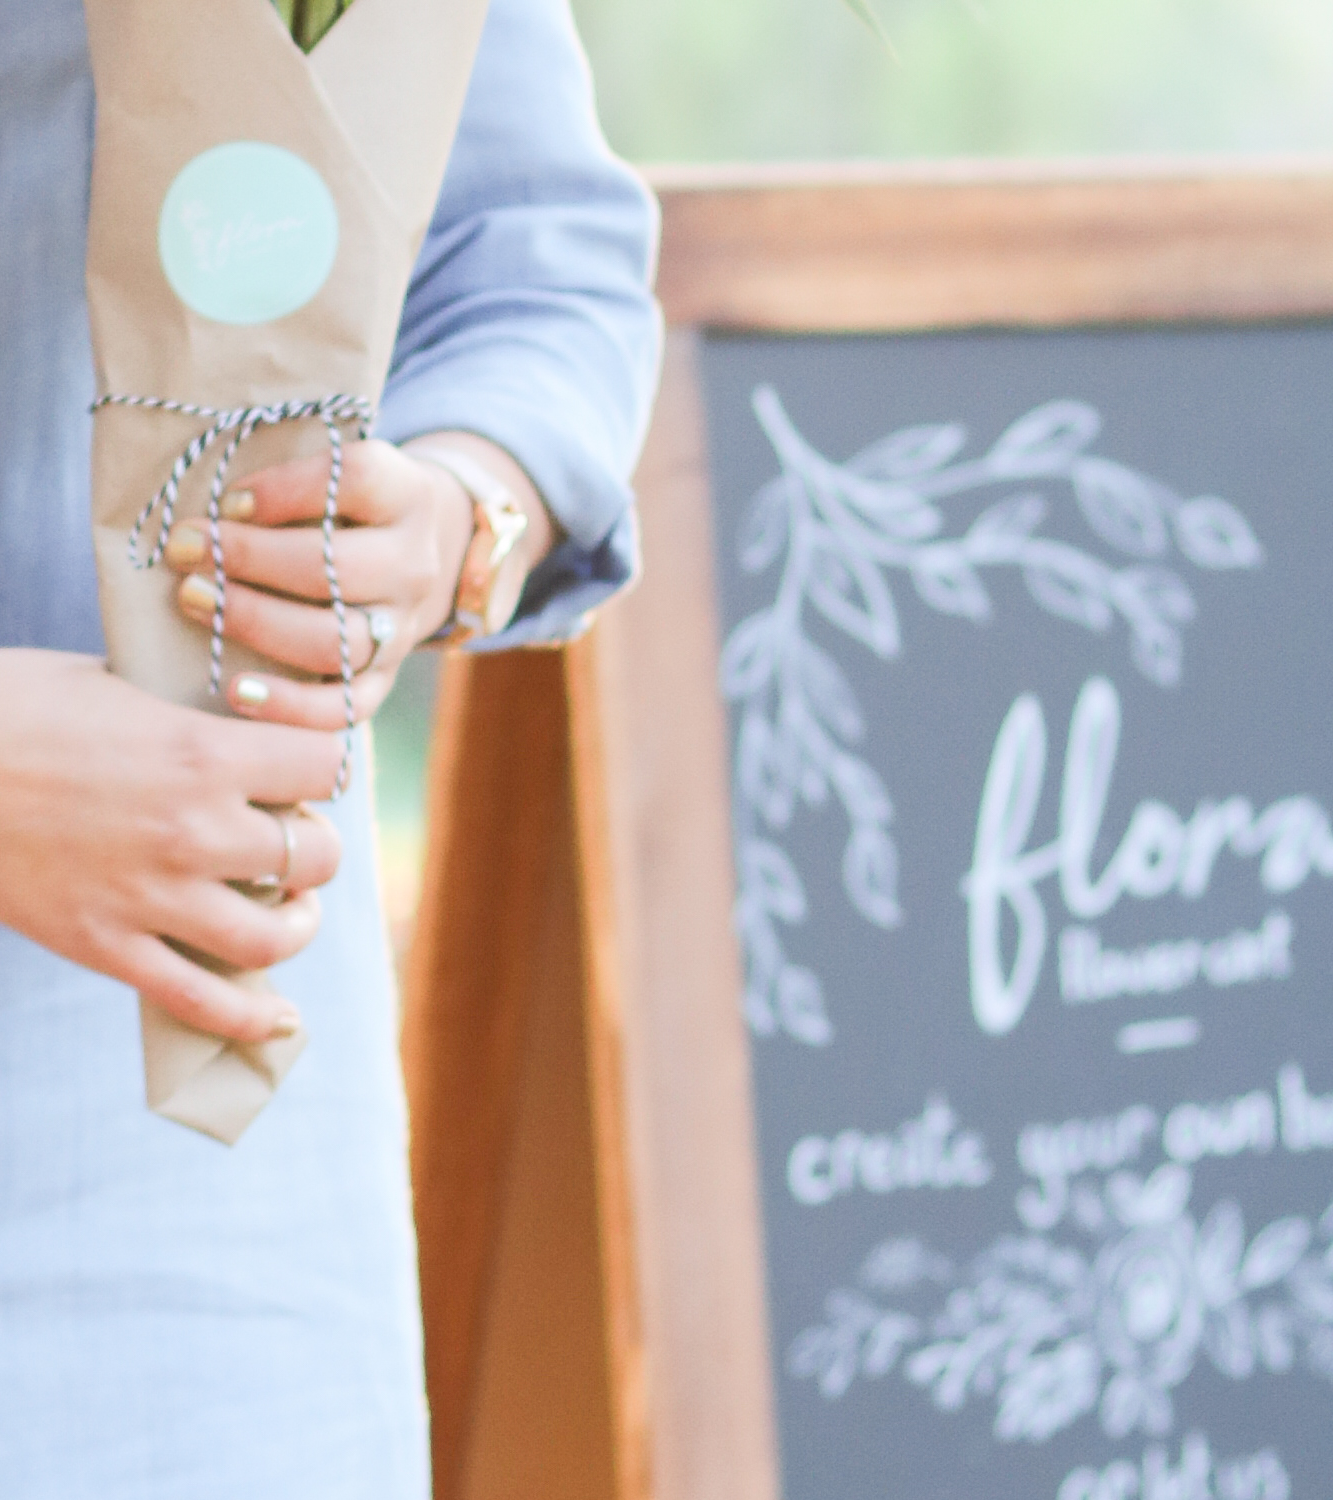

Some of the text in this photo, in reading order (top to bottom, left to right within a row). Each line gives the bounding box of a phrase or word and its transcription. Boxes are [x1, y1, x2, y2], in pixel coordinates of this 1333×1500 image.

[960, 674, 1333, 1036] flora
[785, 1094, 993, 1204] create
[1016, 1105, 1157, 1230] your
[1162, 1089, 1276, 1163] own
